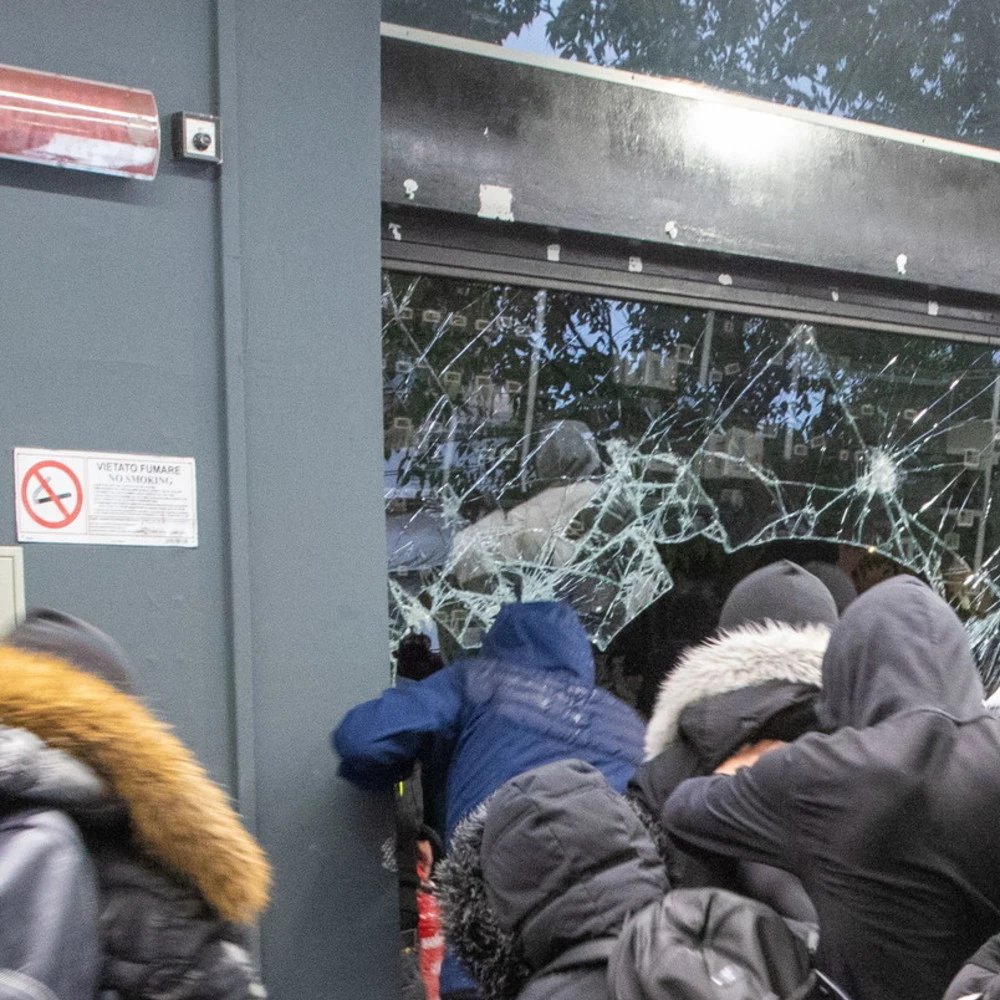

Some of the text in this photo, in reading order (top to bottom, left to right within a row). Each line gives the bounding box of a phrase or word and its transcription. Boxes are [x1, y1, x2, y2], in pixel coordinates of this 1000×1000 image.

[97, 462, 181, 475] VIETATO FUMARE
[109, 474, 173, 485] NO SMOKING
